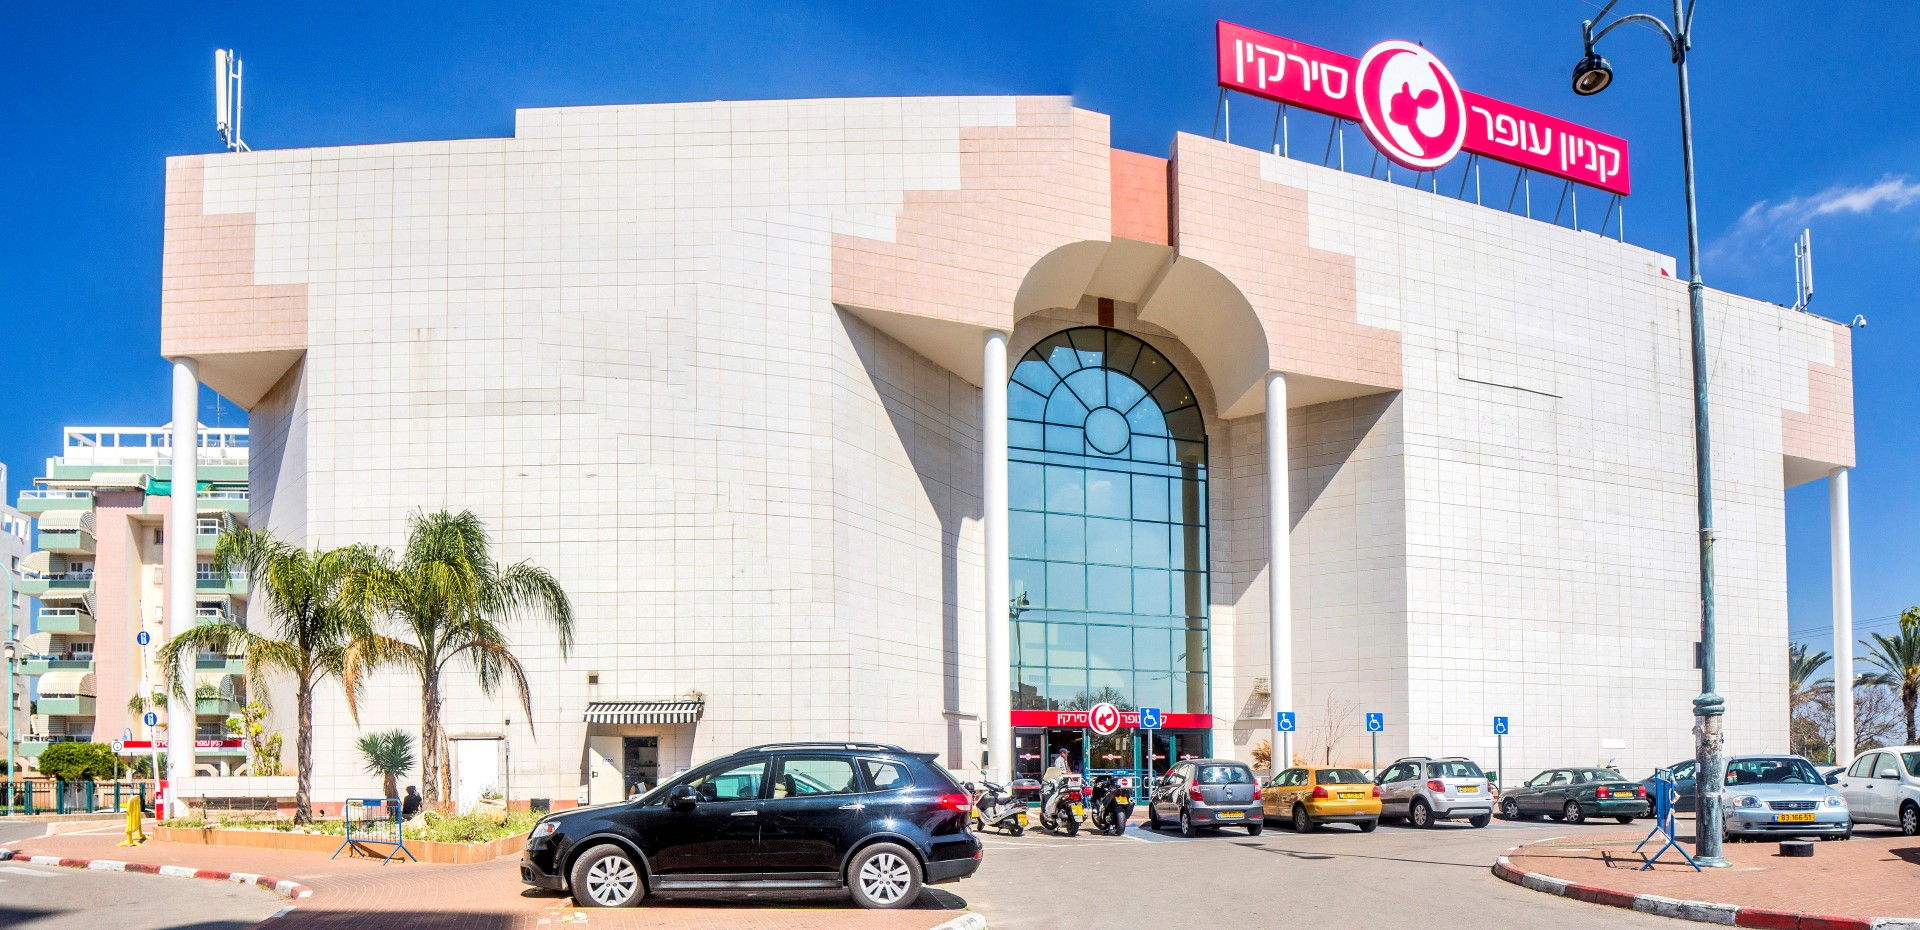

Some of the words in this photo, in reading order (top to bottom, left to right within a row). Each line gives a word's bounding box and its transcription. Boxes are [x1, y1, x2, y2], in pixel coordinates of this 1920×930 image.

[1235, 38, 1349, 99] סירקין
[1472, 105, 1552, 156] עופר
[1560, 131, 1621, 183] קניון
[1057, 713, 1087, 725] סירקין
